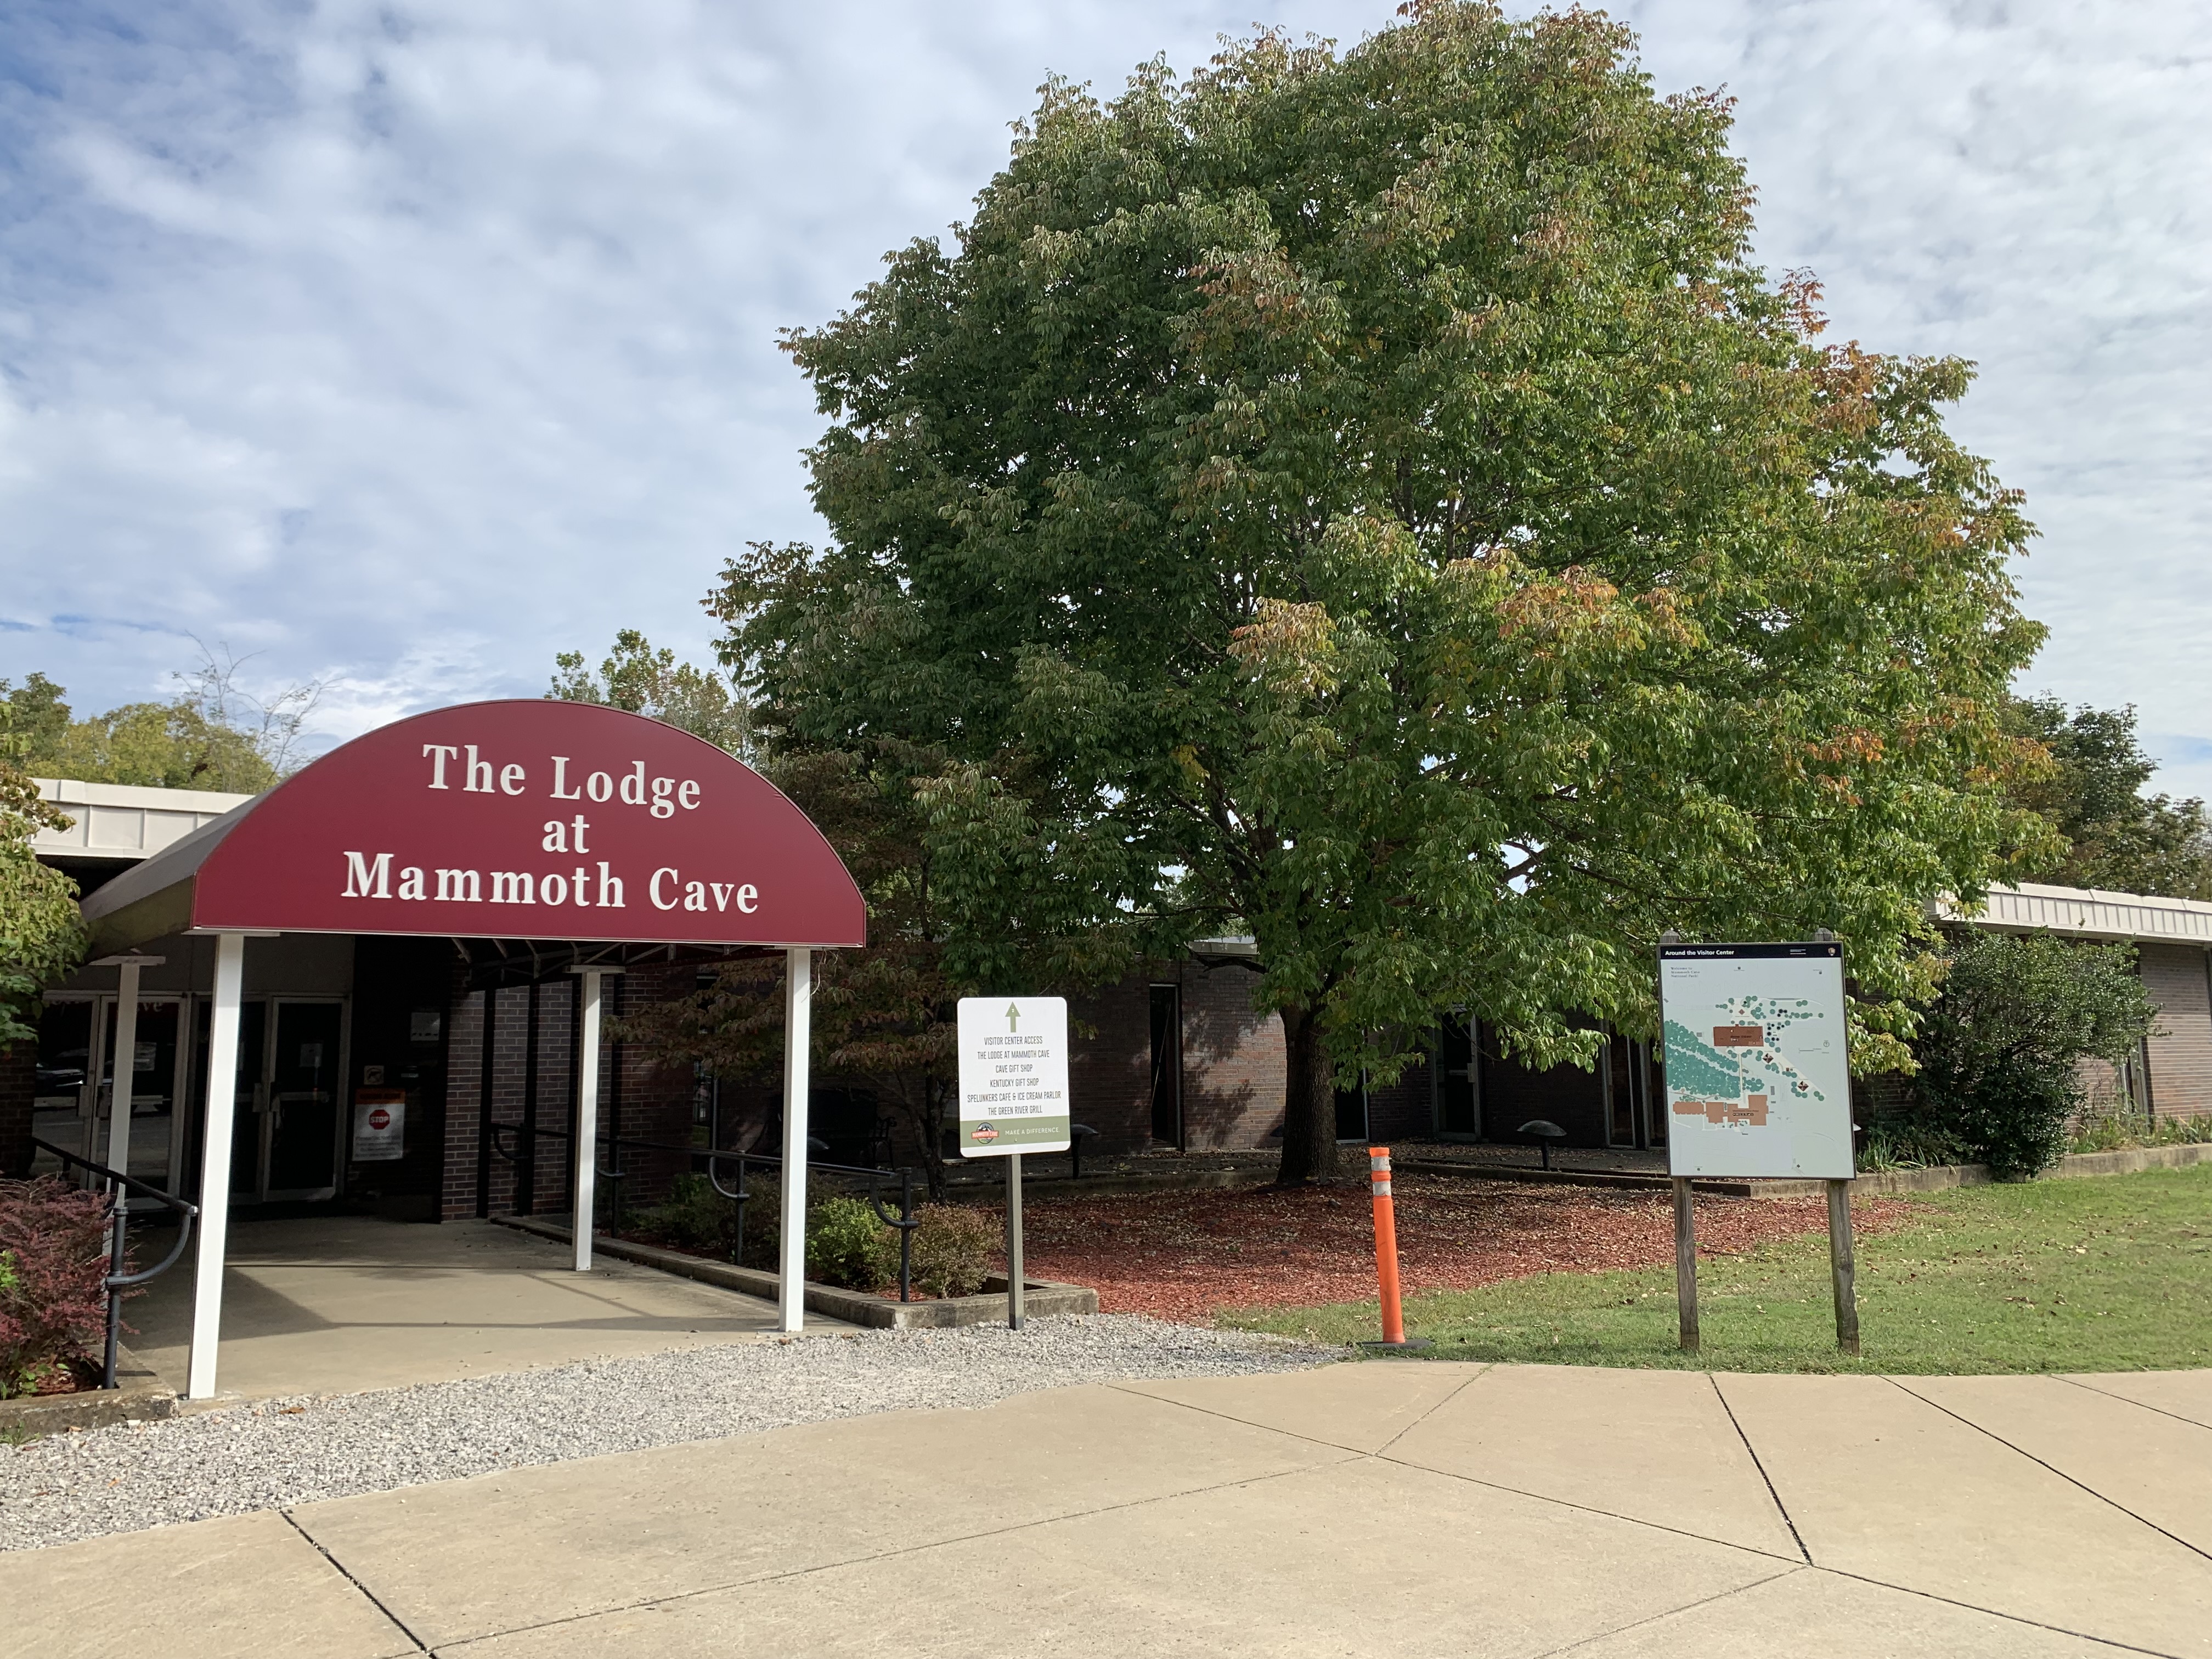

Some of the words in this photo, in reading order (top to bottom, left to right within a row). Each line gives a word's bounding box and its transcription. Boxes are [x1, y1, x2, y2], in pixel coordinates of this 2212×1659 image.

[422, 744, 526, 796] The
[550, 755, 701, 819] Lodge
[542, 814, 590, 854] at
[341, 851, 627, 909] Mammoth
[649, 867, 759, 915] Cave
[984, 1037, 1003, 1045] VISITOR
[1005, 1036, 1023, 1045] CENTER
[1024, 1036, 1043, 1045] ACCESS
[977, 1051, 987, 1059] THE
[988, 1051, 1003, 1059] LODGE
[1004, 1051, 1010, 1059] AT
[1011, 1050, 1037, 1059] MAMMOTH
[1037, 1049, 1050, 1058] CAVE
[995, 1065, 1008, 1073] CAVE
[1009, 1064, 1019, 1073] GIFT
[1020, 1064, 1033, 1072] SHOP
[990, 1079, 1014, 1087] KENTUCKY
[1015, 1079, 1025, 1087] GIFT
[1026, 1078, 1039, 1086] SHOP
[967, 1093, 998, 1103] SPELUNKERS
[999, 1092, 1011, 1101] CAFÉ
[1012, 1092, 1017, 1101] &
[1026, 1092, 1043, 1100] CREAM
[1043, 1091, 1061, 1099] PARLOR
[988, 1107, 997, 1115] THE
[998, 1107, 1013, 1115] GREEN
[1014, 1106, 1028, 1114] RIVER
[1029, 1105, 1043, 1114] GRILL
